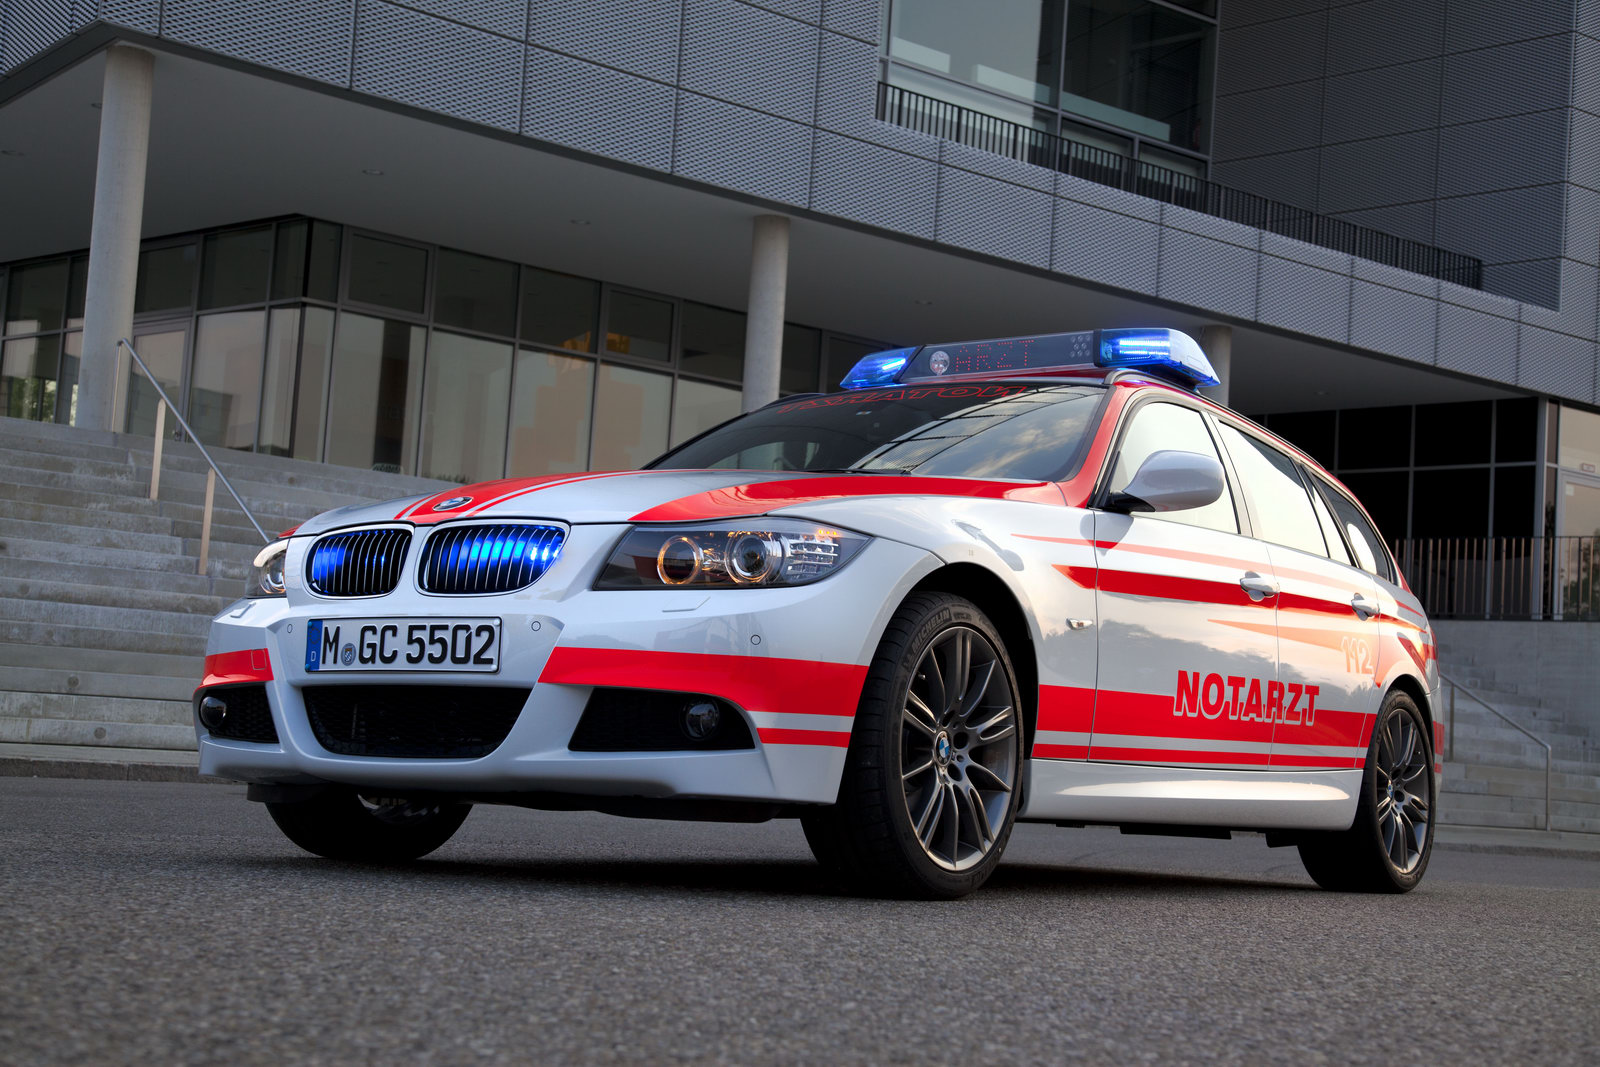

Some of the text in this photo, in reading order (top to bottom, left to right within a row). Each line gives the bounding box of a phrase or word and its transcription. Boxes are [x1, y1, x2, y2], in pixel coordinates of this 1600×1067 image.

[955, 339, 1035, 372] ARZT
[322, 624, 496, 665] M GC 5502
[911, 607, 952, 654] MICHELIN
[310, 650, 317, 662] D
[1340, 636, 1376, 676] 112
[1172, 669, 1320, 727] NOTARZT
